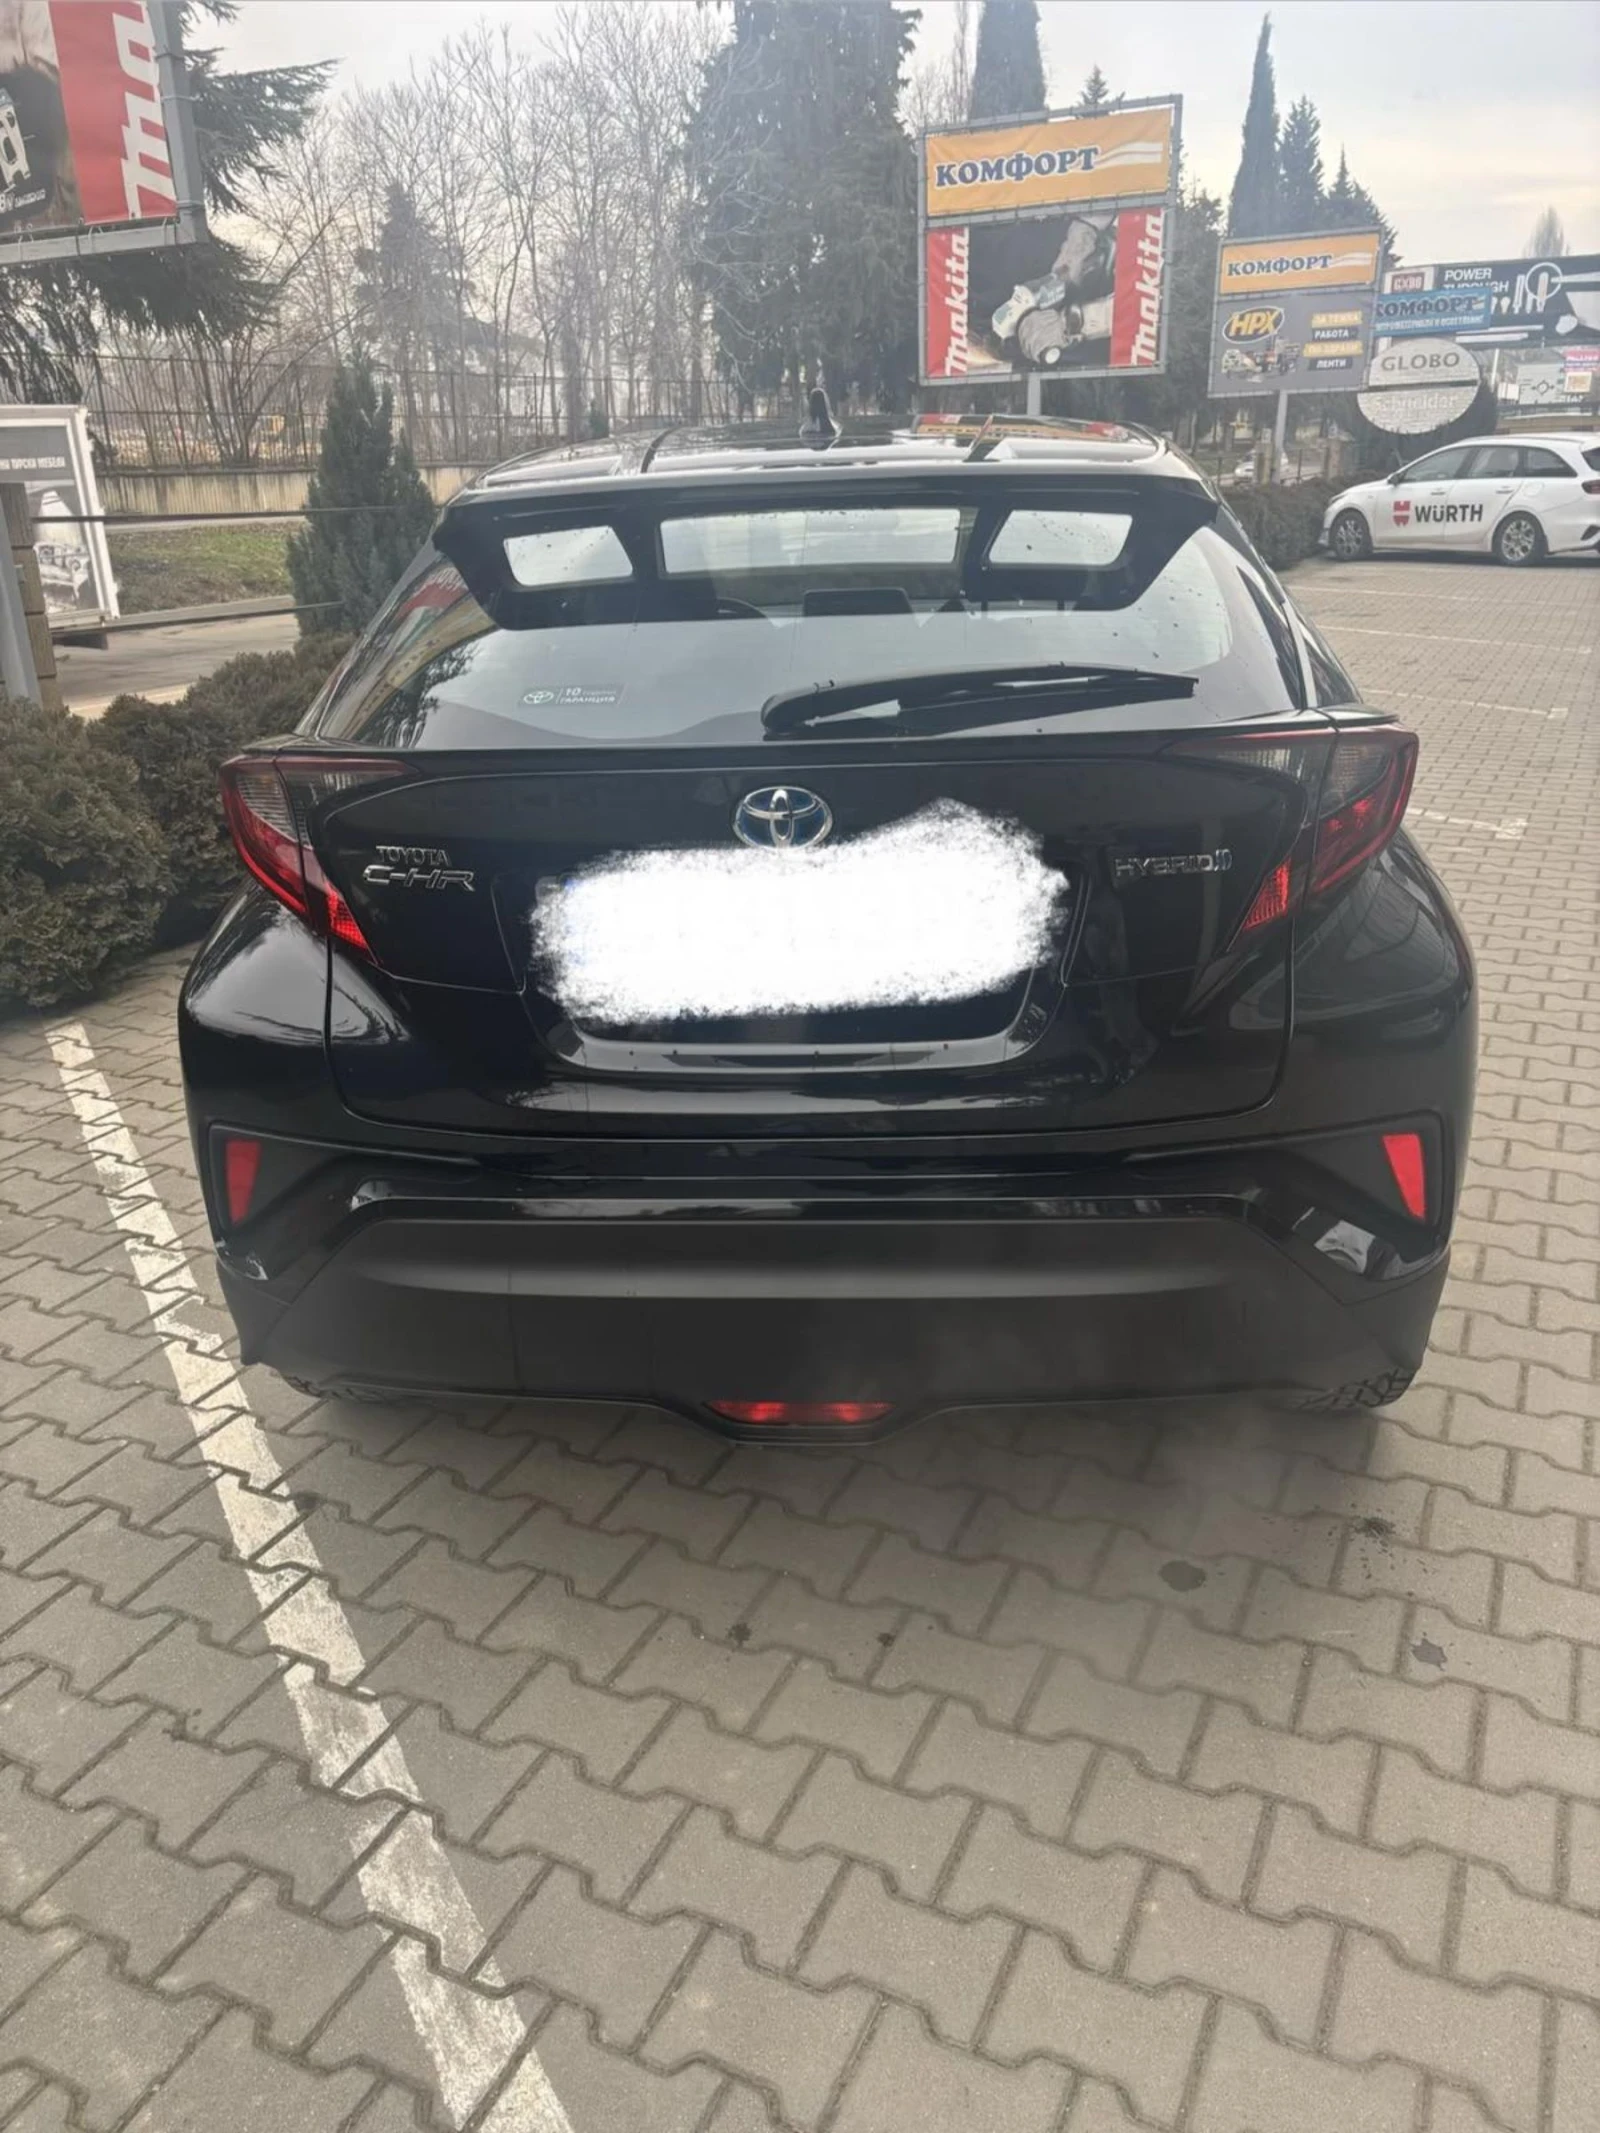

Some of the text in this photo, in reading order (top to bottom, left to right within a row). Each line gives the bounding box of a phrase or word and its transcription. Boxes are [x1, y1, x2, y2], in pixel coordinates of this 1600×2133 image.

[112, 10, 177, 220] ma
[936, 147, 1098, 186] КОМФОРТ
[1228, 255, 1332, 276] КОМФОРТ
[1444, 268, 1492, 282] POWER
[1130, 211, 1164, 366] makita
[945, 227, 969, 376] makita
[1229, 309, 1279, 337] HPX
[1314, 329, 1349, 340] РАБОТА
[1381, 352, 1460, 371] GLOBO
[1415, 504, 1483, 524] WÜRTH
[566, 687, 582, 696] 10
[376, 845, 451, 867] TOYOTA
[1115, 854, 1214, 877] HYBRID
[363, 864, 475, 893] C-HR
